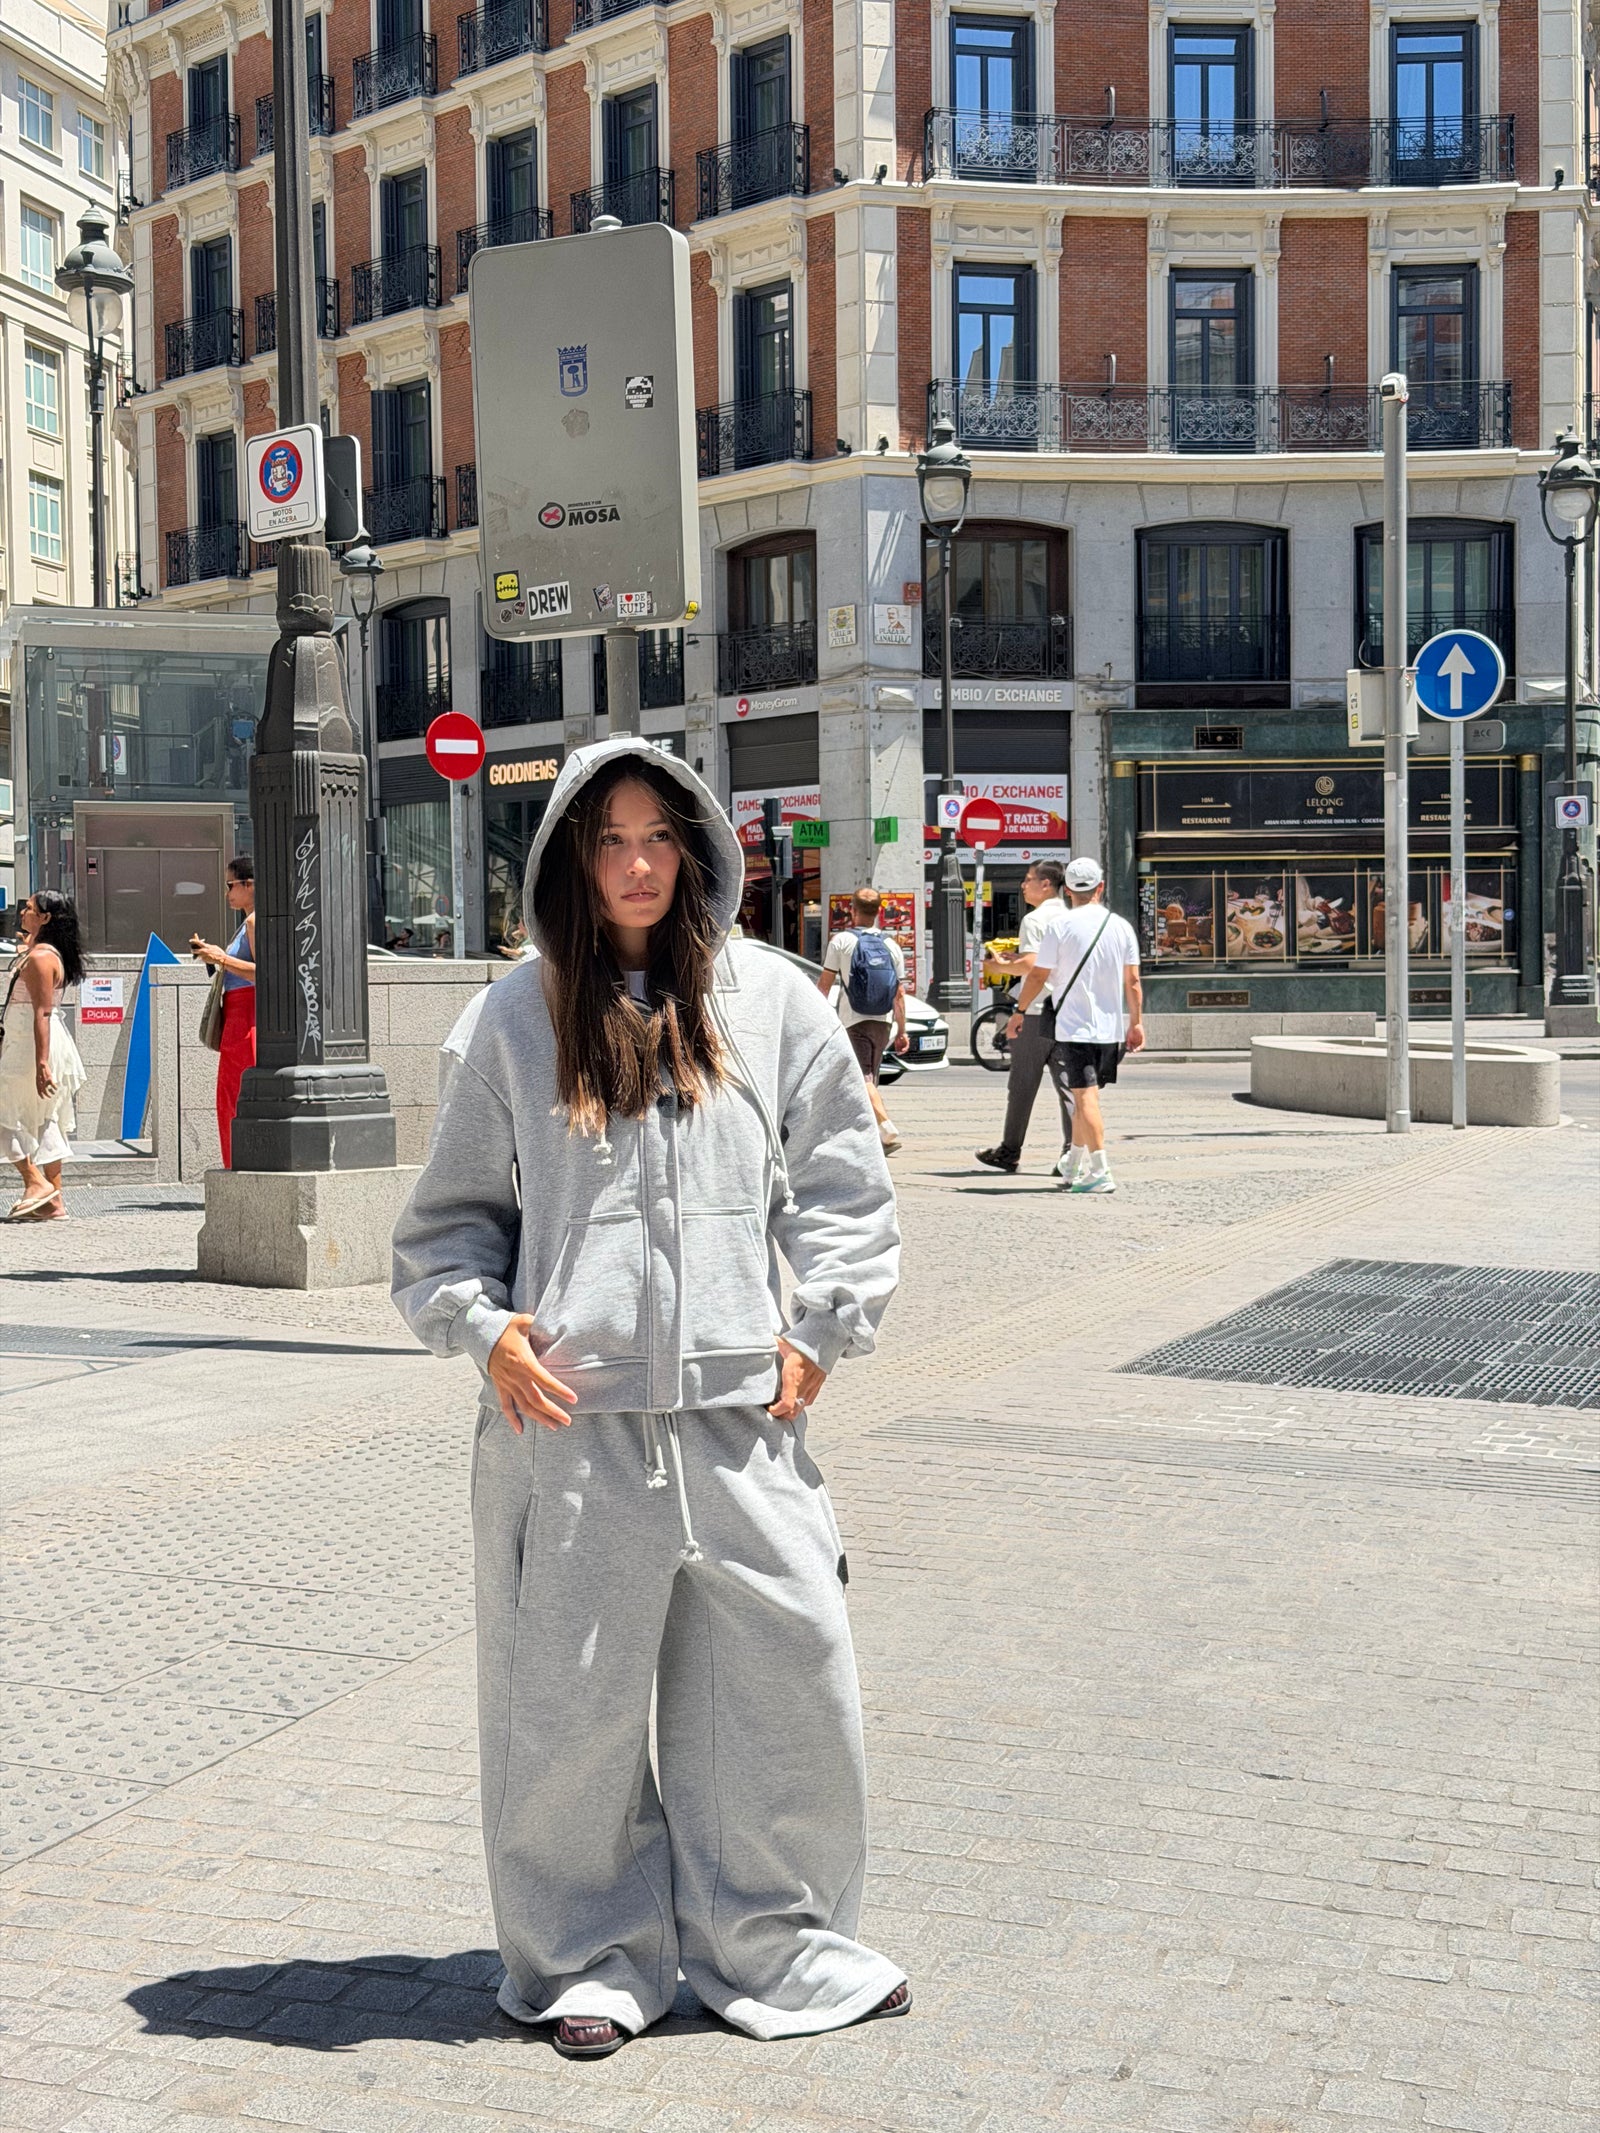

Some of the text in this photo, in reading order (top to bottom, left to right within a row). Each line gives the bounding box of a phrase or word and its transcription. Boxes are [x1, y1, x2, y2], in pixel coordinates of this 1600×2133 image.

[272, 507, 293, 517] MOTOS
[568, 507, 621, 526] MOSA
[278, 515, 297, 525] ACERA
[528, 585, 568, 616] DREW
[635, 593, 646, 602] DE
[934, 688, 982, 701] CMBIO
[995, 689, 1062, 702] EXCHANGE
[750, 697, 797, 711] MoneyGram
[489, 758, 558, 786] GOODNEWS
[993, 786, 1063, 798] EXCHANGE
[1306, 798, 1344, 807] LELONG
[799, 823, 824, 837] ATM
[1008, 825, 1047, 833] DE MADRID
[87, 1009, 119, 1019] Pickup
